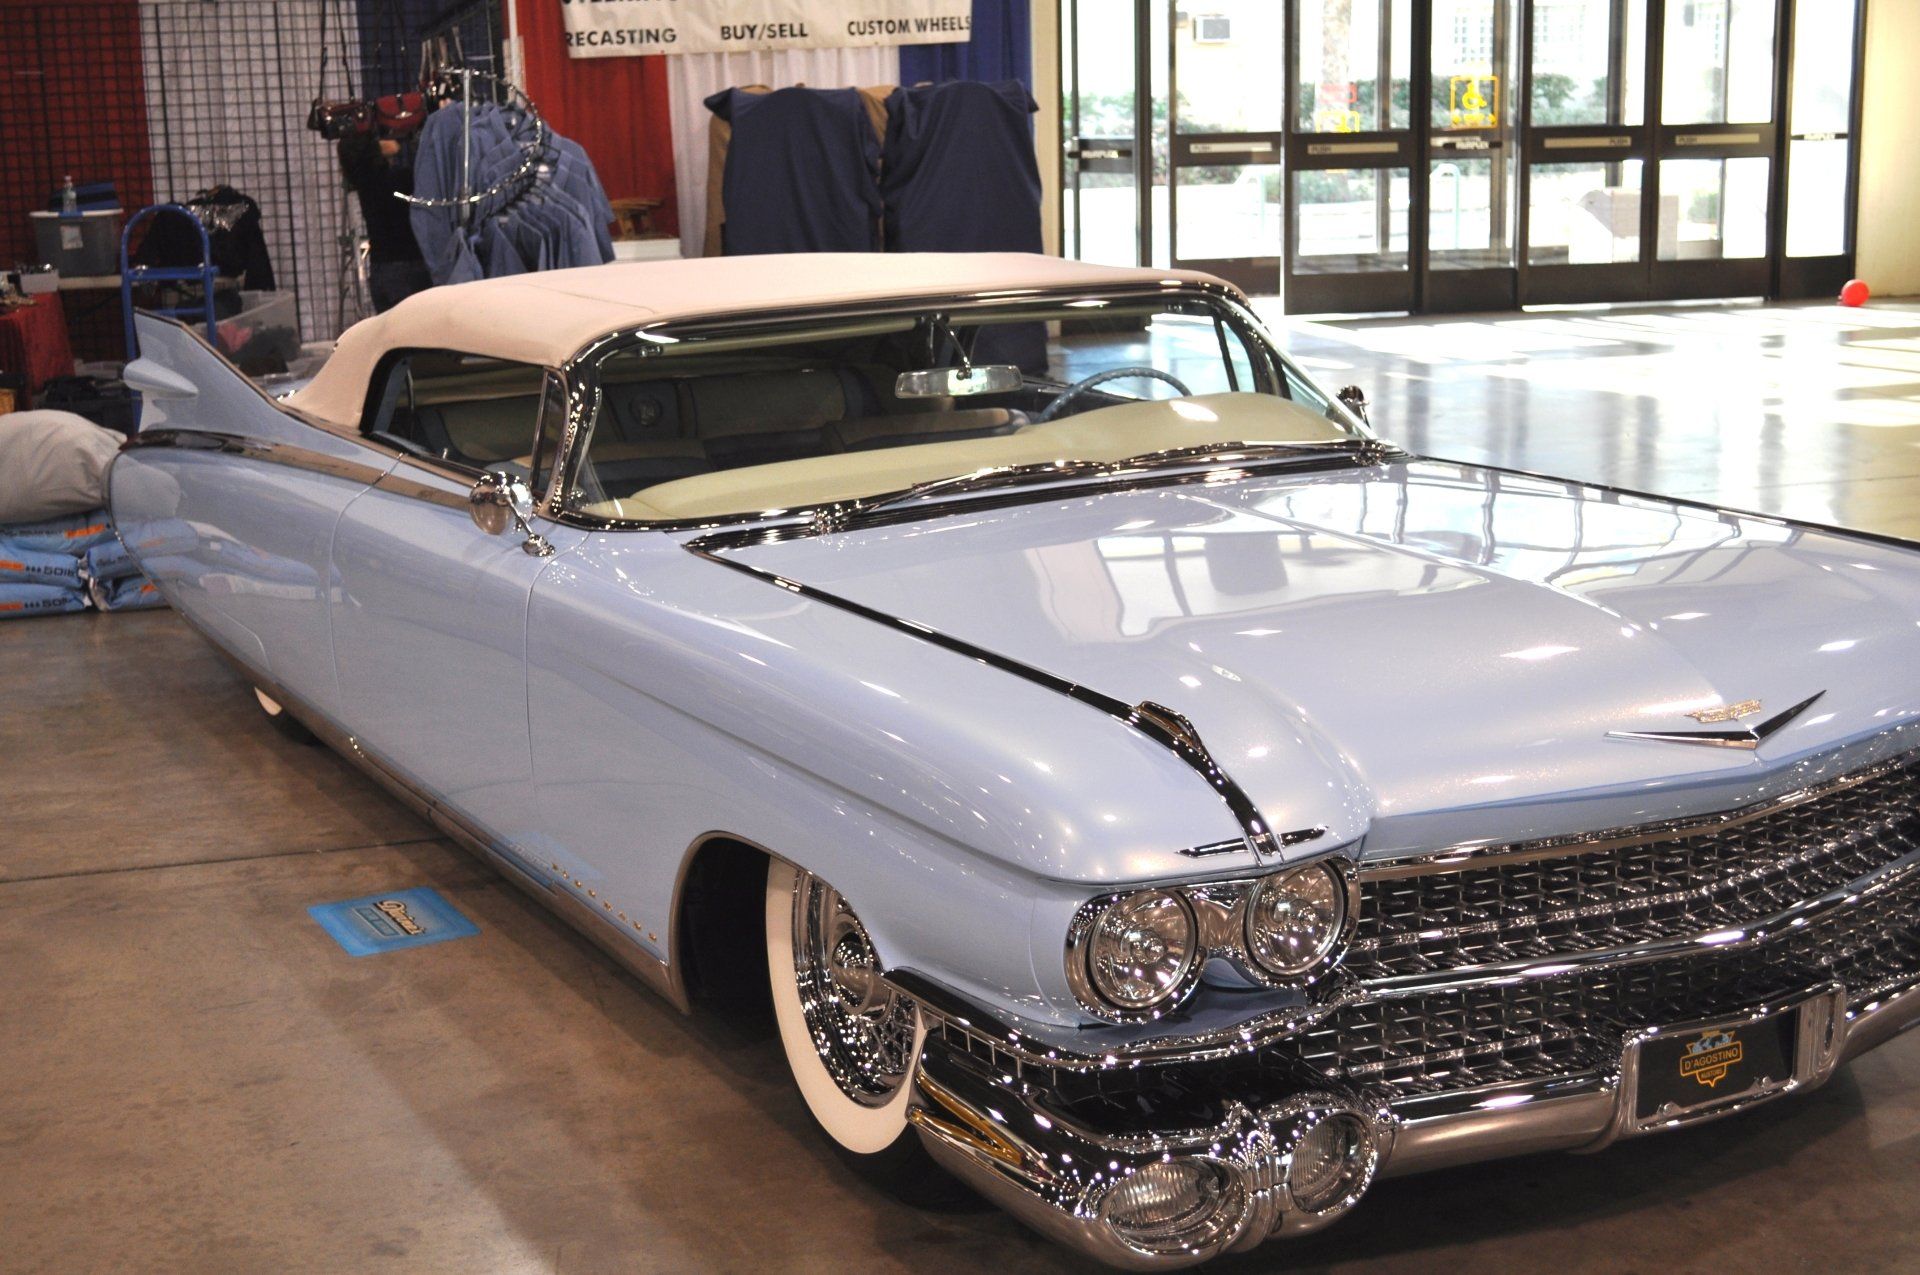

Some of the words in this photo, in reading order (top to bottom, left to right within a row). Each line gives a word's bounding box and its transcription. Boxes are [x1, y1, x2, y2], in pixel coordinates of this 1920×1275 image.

[564, 28, 677, 47] RECASTING
[720, 22, 809, 40] BUY/SELL
[847, 18, 911, 37] CUSTOM
[914, 15, 971, 33] WHEELS
[1684, 1047, 1739, 1071] D'AGOSTINO
